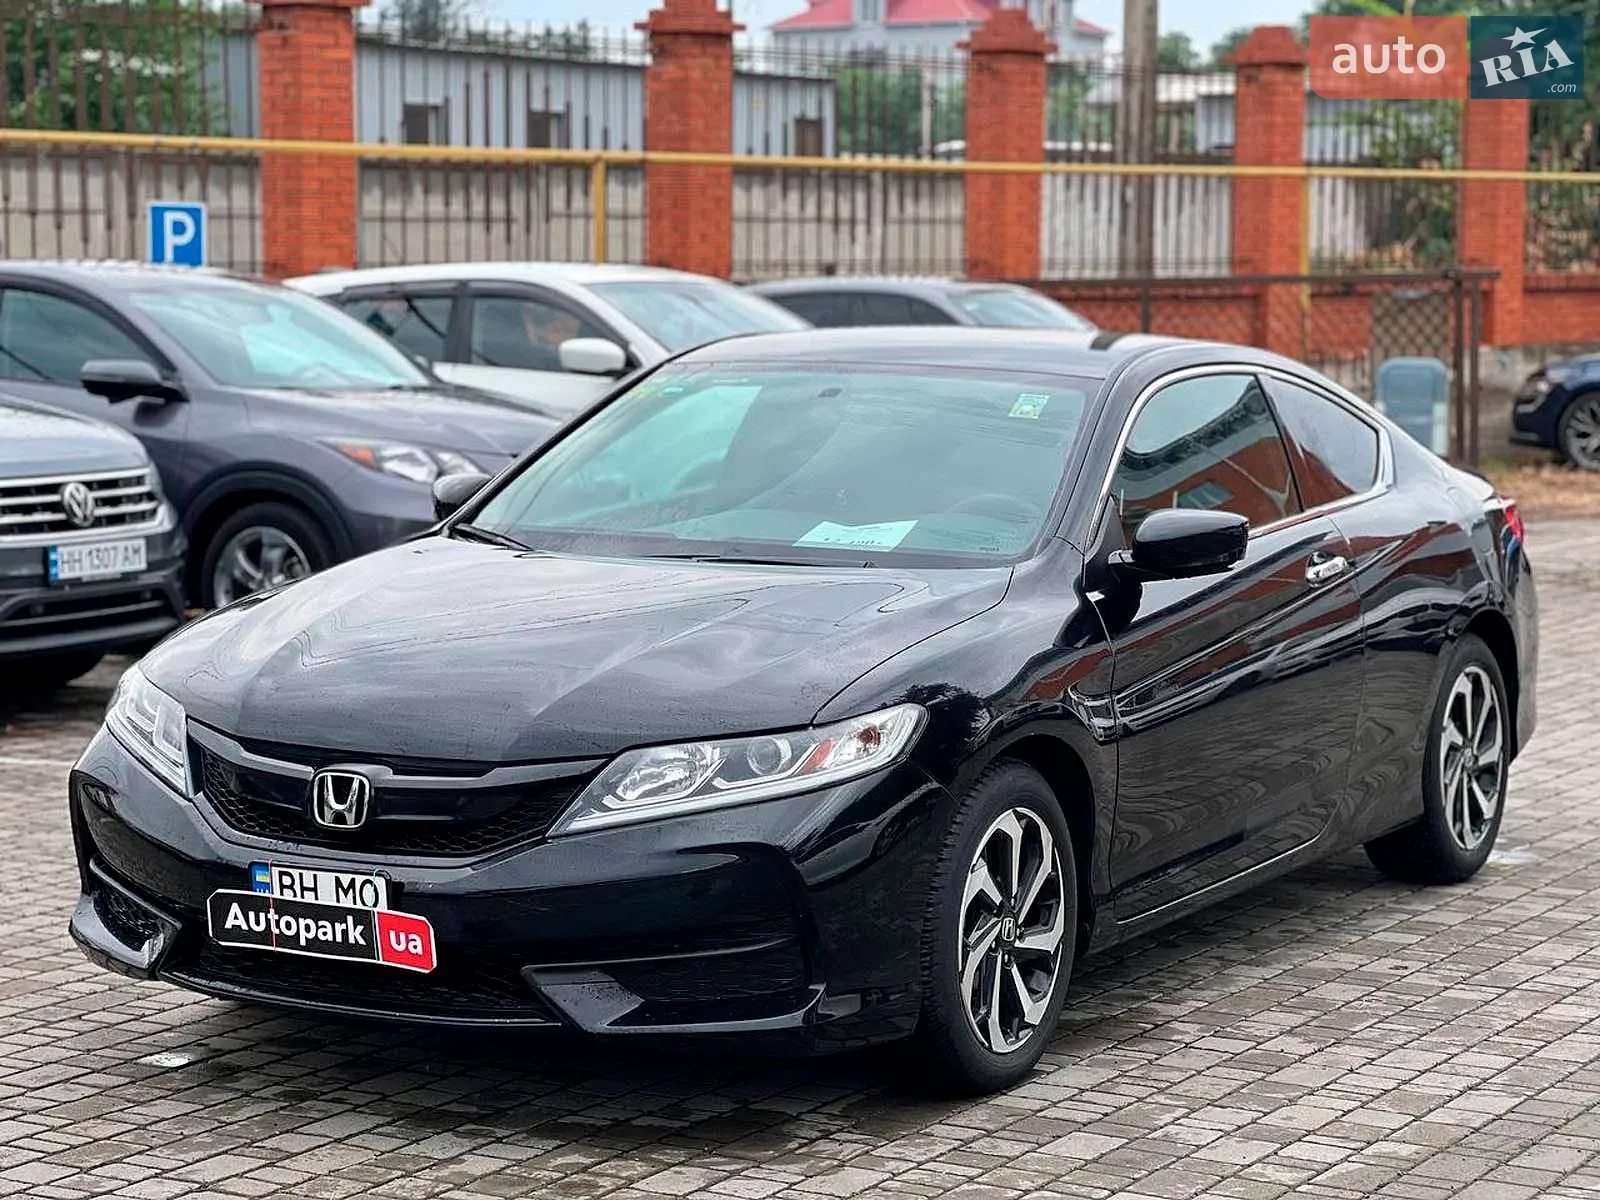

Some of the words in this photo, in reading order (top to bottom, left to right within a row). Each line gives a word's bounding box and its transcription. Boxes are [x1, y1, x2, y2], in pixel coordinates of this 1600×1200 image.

[163, 210, 196, 263] P
[60, 549, 83, 574] HH
[224, 902, 367, 946] Autopark
[389, 929, 424, 956] ua
